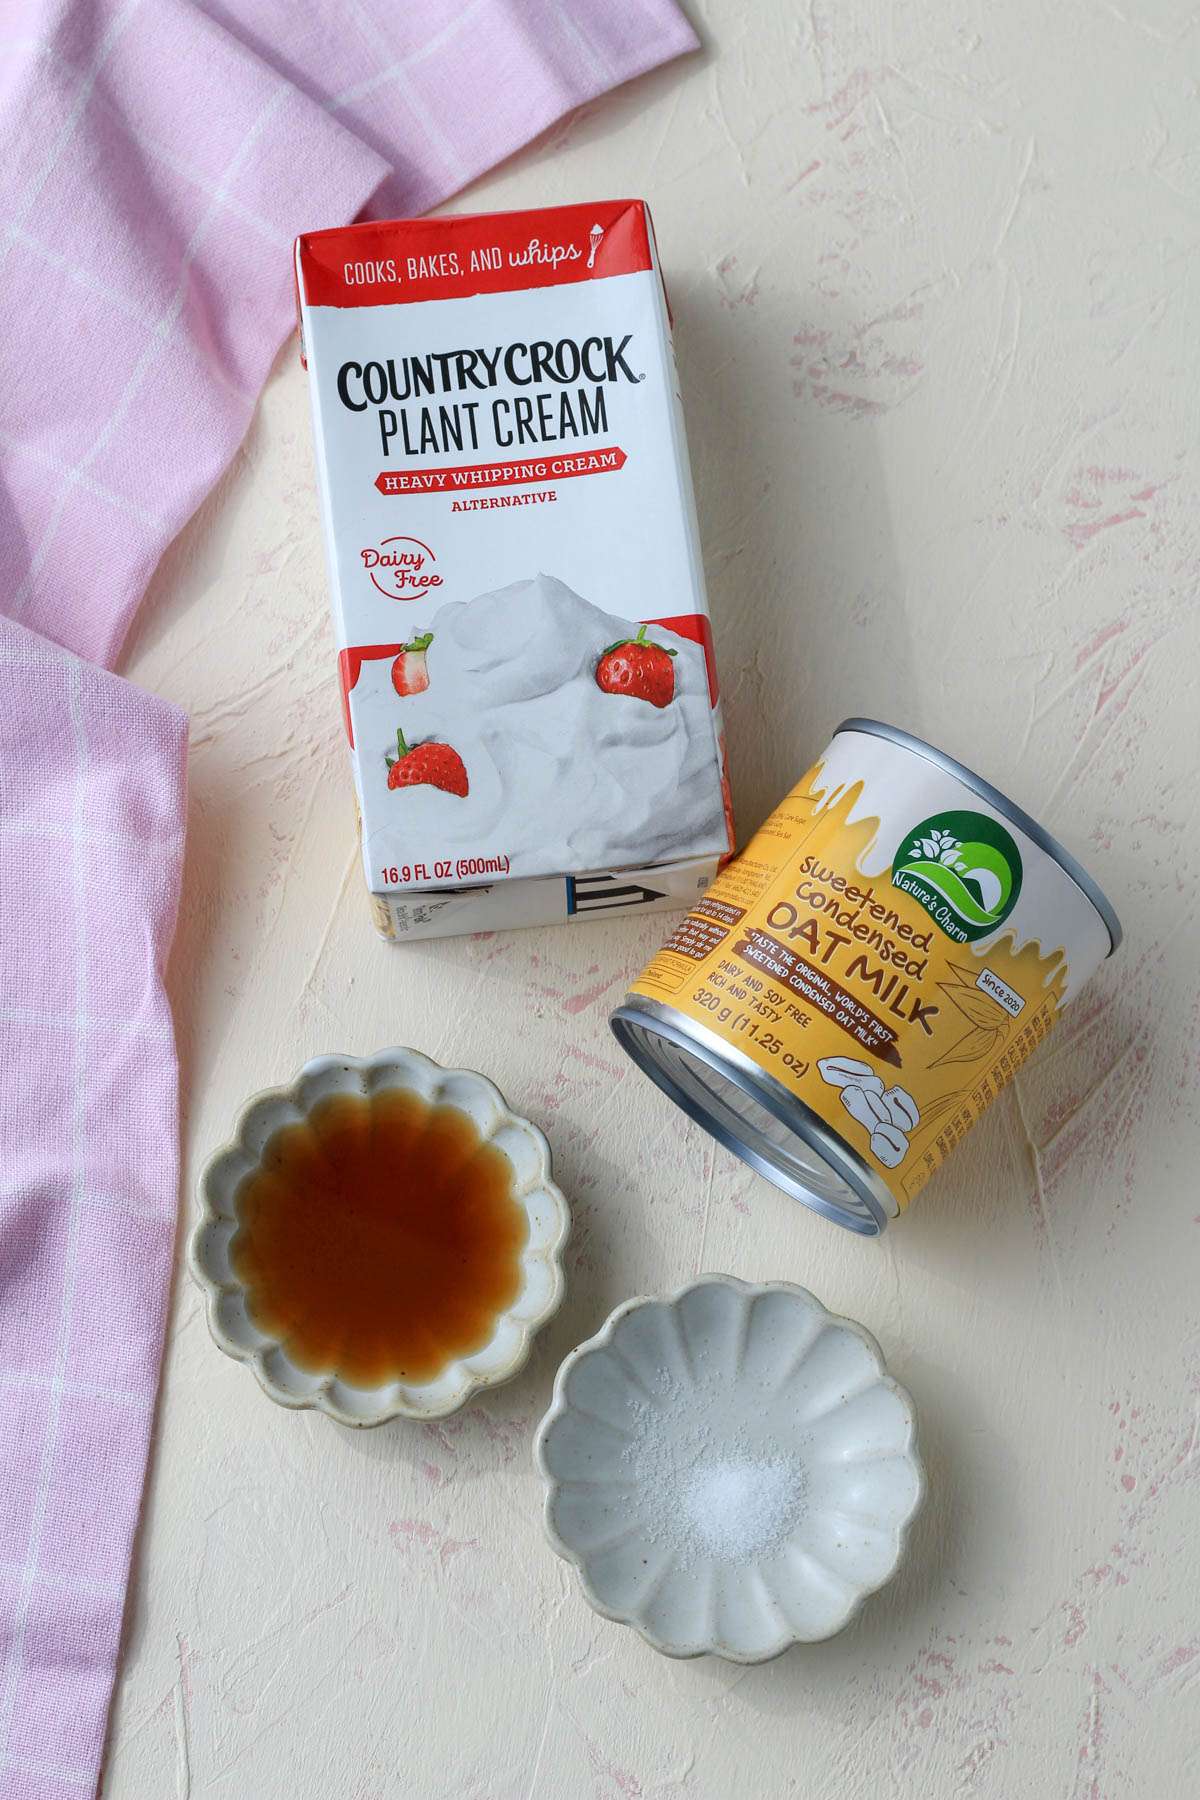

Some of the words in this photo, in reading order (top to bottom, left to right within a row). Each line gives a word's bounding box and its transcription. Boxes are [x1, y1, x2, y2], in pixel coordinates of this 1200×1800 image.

[344, 259, 402, 285] COOKS,
[407, 252, 464, 280] BAKES,
[470, 247, 502, 273] AND
[508, 238, 583, 270] whips
[378, 402, 479, 456] PLANT
[492, 386, 609, 447] CREAM
[385, 473, 448, 490] HEAVY
[451, 463, 547, 485] WHIPPING
[551, 452, 617, 474] CREAM
[451, 490, 557, 512] ALTERNATIVE
[361, 548, 425, 571] Dairy
[394, 569, 444, 589] Free
[381, 866, 411, 884] 16.9
[414, 863, 431, 881] FL
[434, 861, 453, 879] OZ
[456, 854, 510, 879] (500mL)
[892, 871, 937, 912] Nature's
[935, 906, 968, 944] Charm
[718, 959, 744, 977] DAIRY
[743, 975, 763, 992] AND
[763, 990, 786, 1006] SOY
[785, 1005, 812, 1029] FREE
[743, 944, 789, 979] SWEETENED
[788, 975, 836, 1013] CONDENSED
[835, 1010, 856, 1029] OAT
[766, 901, 852, 964] OAT
[844, 954, 940, 1036] MILK
[982, 973, 1005, 998] Since
[1003, 993, 1021, 1013] 2020
[706, 971, 728, 988] RICH
[726, 984, 747, 1001] AND
[749, 997, 783, 1024] TASTY
[779, 949, 797, 967] THE
[795, 962, 832, 996] ORIGINAL,
[834, 991, 870, 1023] WORLD'S
[870, 1019, 894, 1042] FIRST
[692, 987, 721, 1012] 320
[718, 1006, 733, 1023] g
[731, 1012, 784, 1056] (11.25
[782, 1053, 810, 1079] oz)
